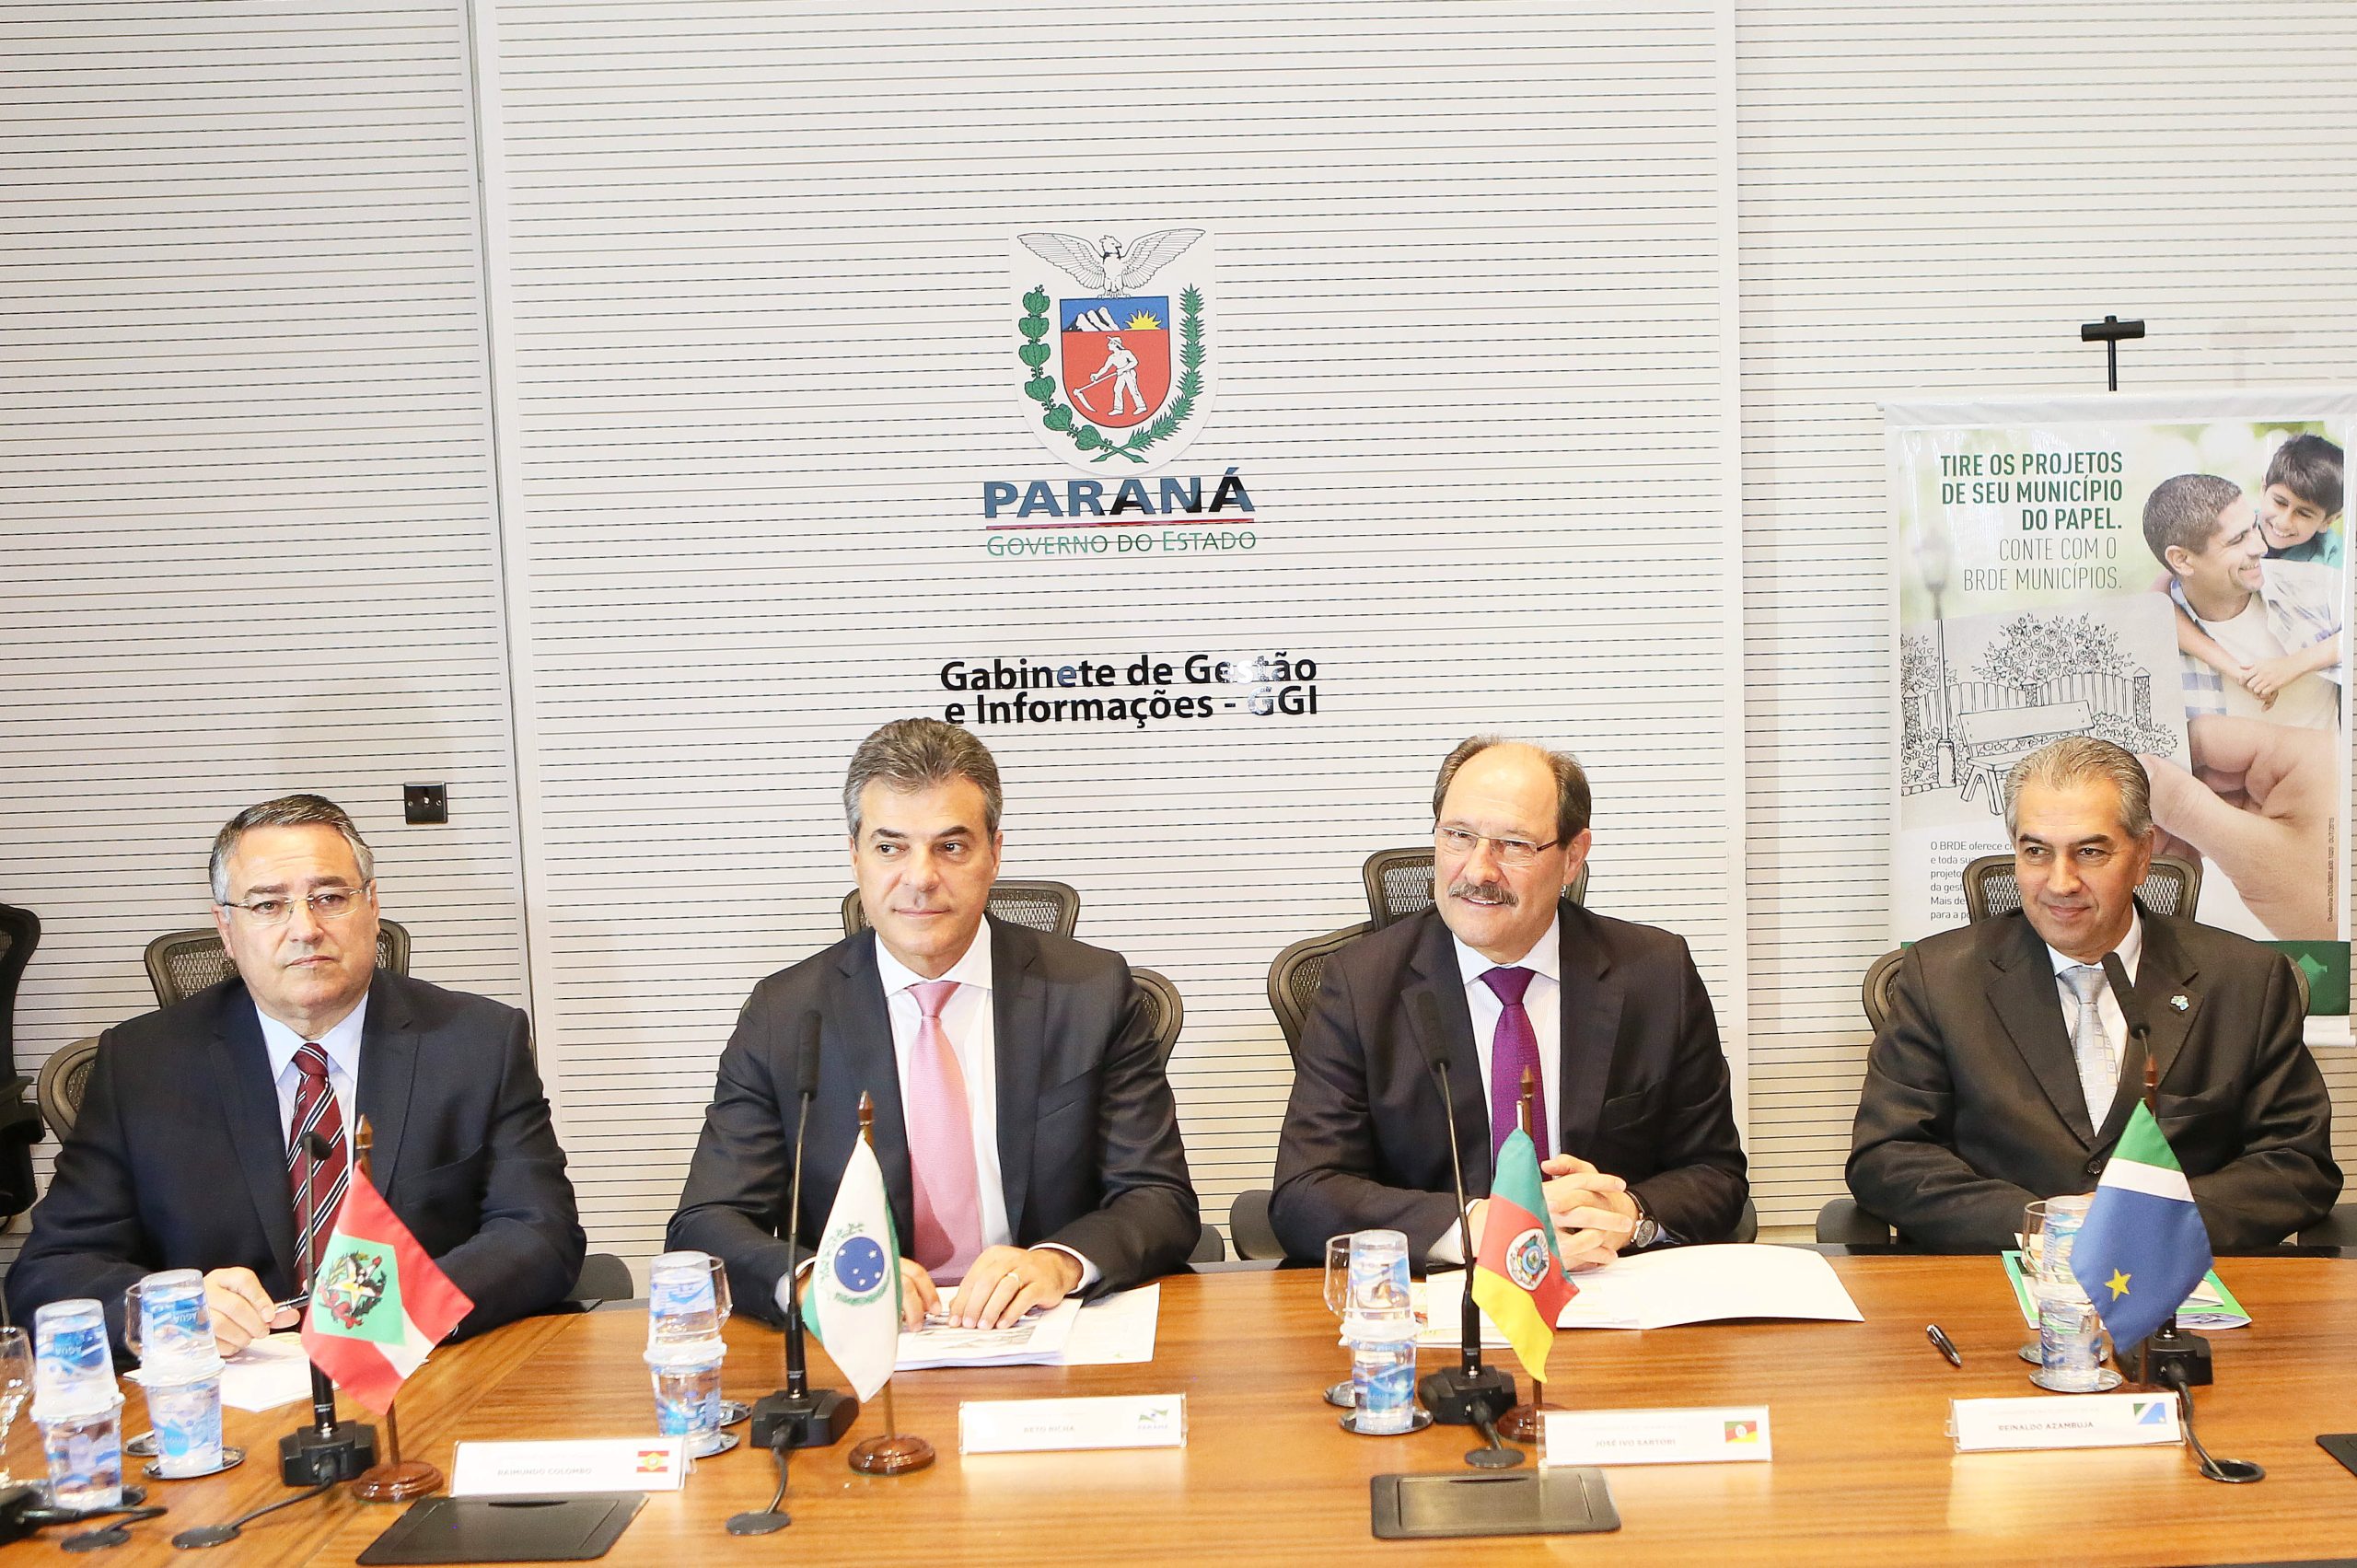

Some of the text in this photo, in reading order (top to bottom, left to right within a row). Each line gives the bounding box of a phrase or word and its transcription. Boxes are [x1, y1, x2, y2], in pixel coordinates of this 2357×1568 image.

[1940, 451, 2122, 477] TIRE OS PROJETOS
[983, 467, 1255, 518] PARANÁ
[1942, 475, 2122, 505] DE SEU MUNICÍPIO
[2022, 507, 2122, 531] DO PAPEL.
[987, 530, 1257, 557] GOVERNO DO ESTADO
[1999, 536, 2117, 562] CONTE COM O
[1964, 562, 2122, 592] BRDE MUNICÍPIOS.
[941, 651, 1317, 691] Gabinete de Gestão
[945, 701, 966, 725] e
[977, 688, 1213, 729] Informações
[1247, 684, 1318, 716] GGI
[1930, 842, 1938, 851] O
[1940, 841, 1967, 851] BRDE
[1968, 841, 2003, 851] oferece
[1938, 855, 1958, 865] toda
[1930, 883, 1942, 892] da
[1930, 896, 1953, 905] Mais
[1930, 911, 1951, 921] para
[1998, 1422, 2095, 1432] REINALDO AZAMBUJA
[1637, 1438, 1677, 1446] SARTORI
[547, 1467, 592, 1475] COLOMBO
